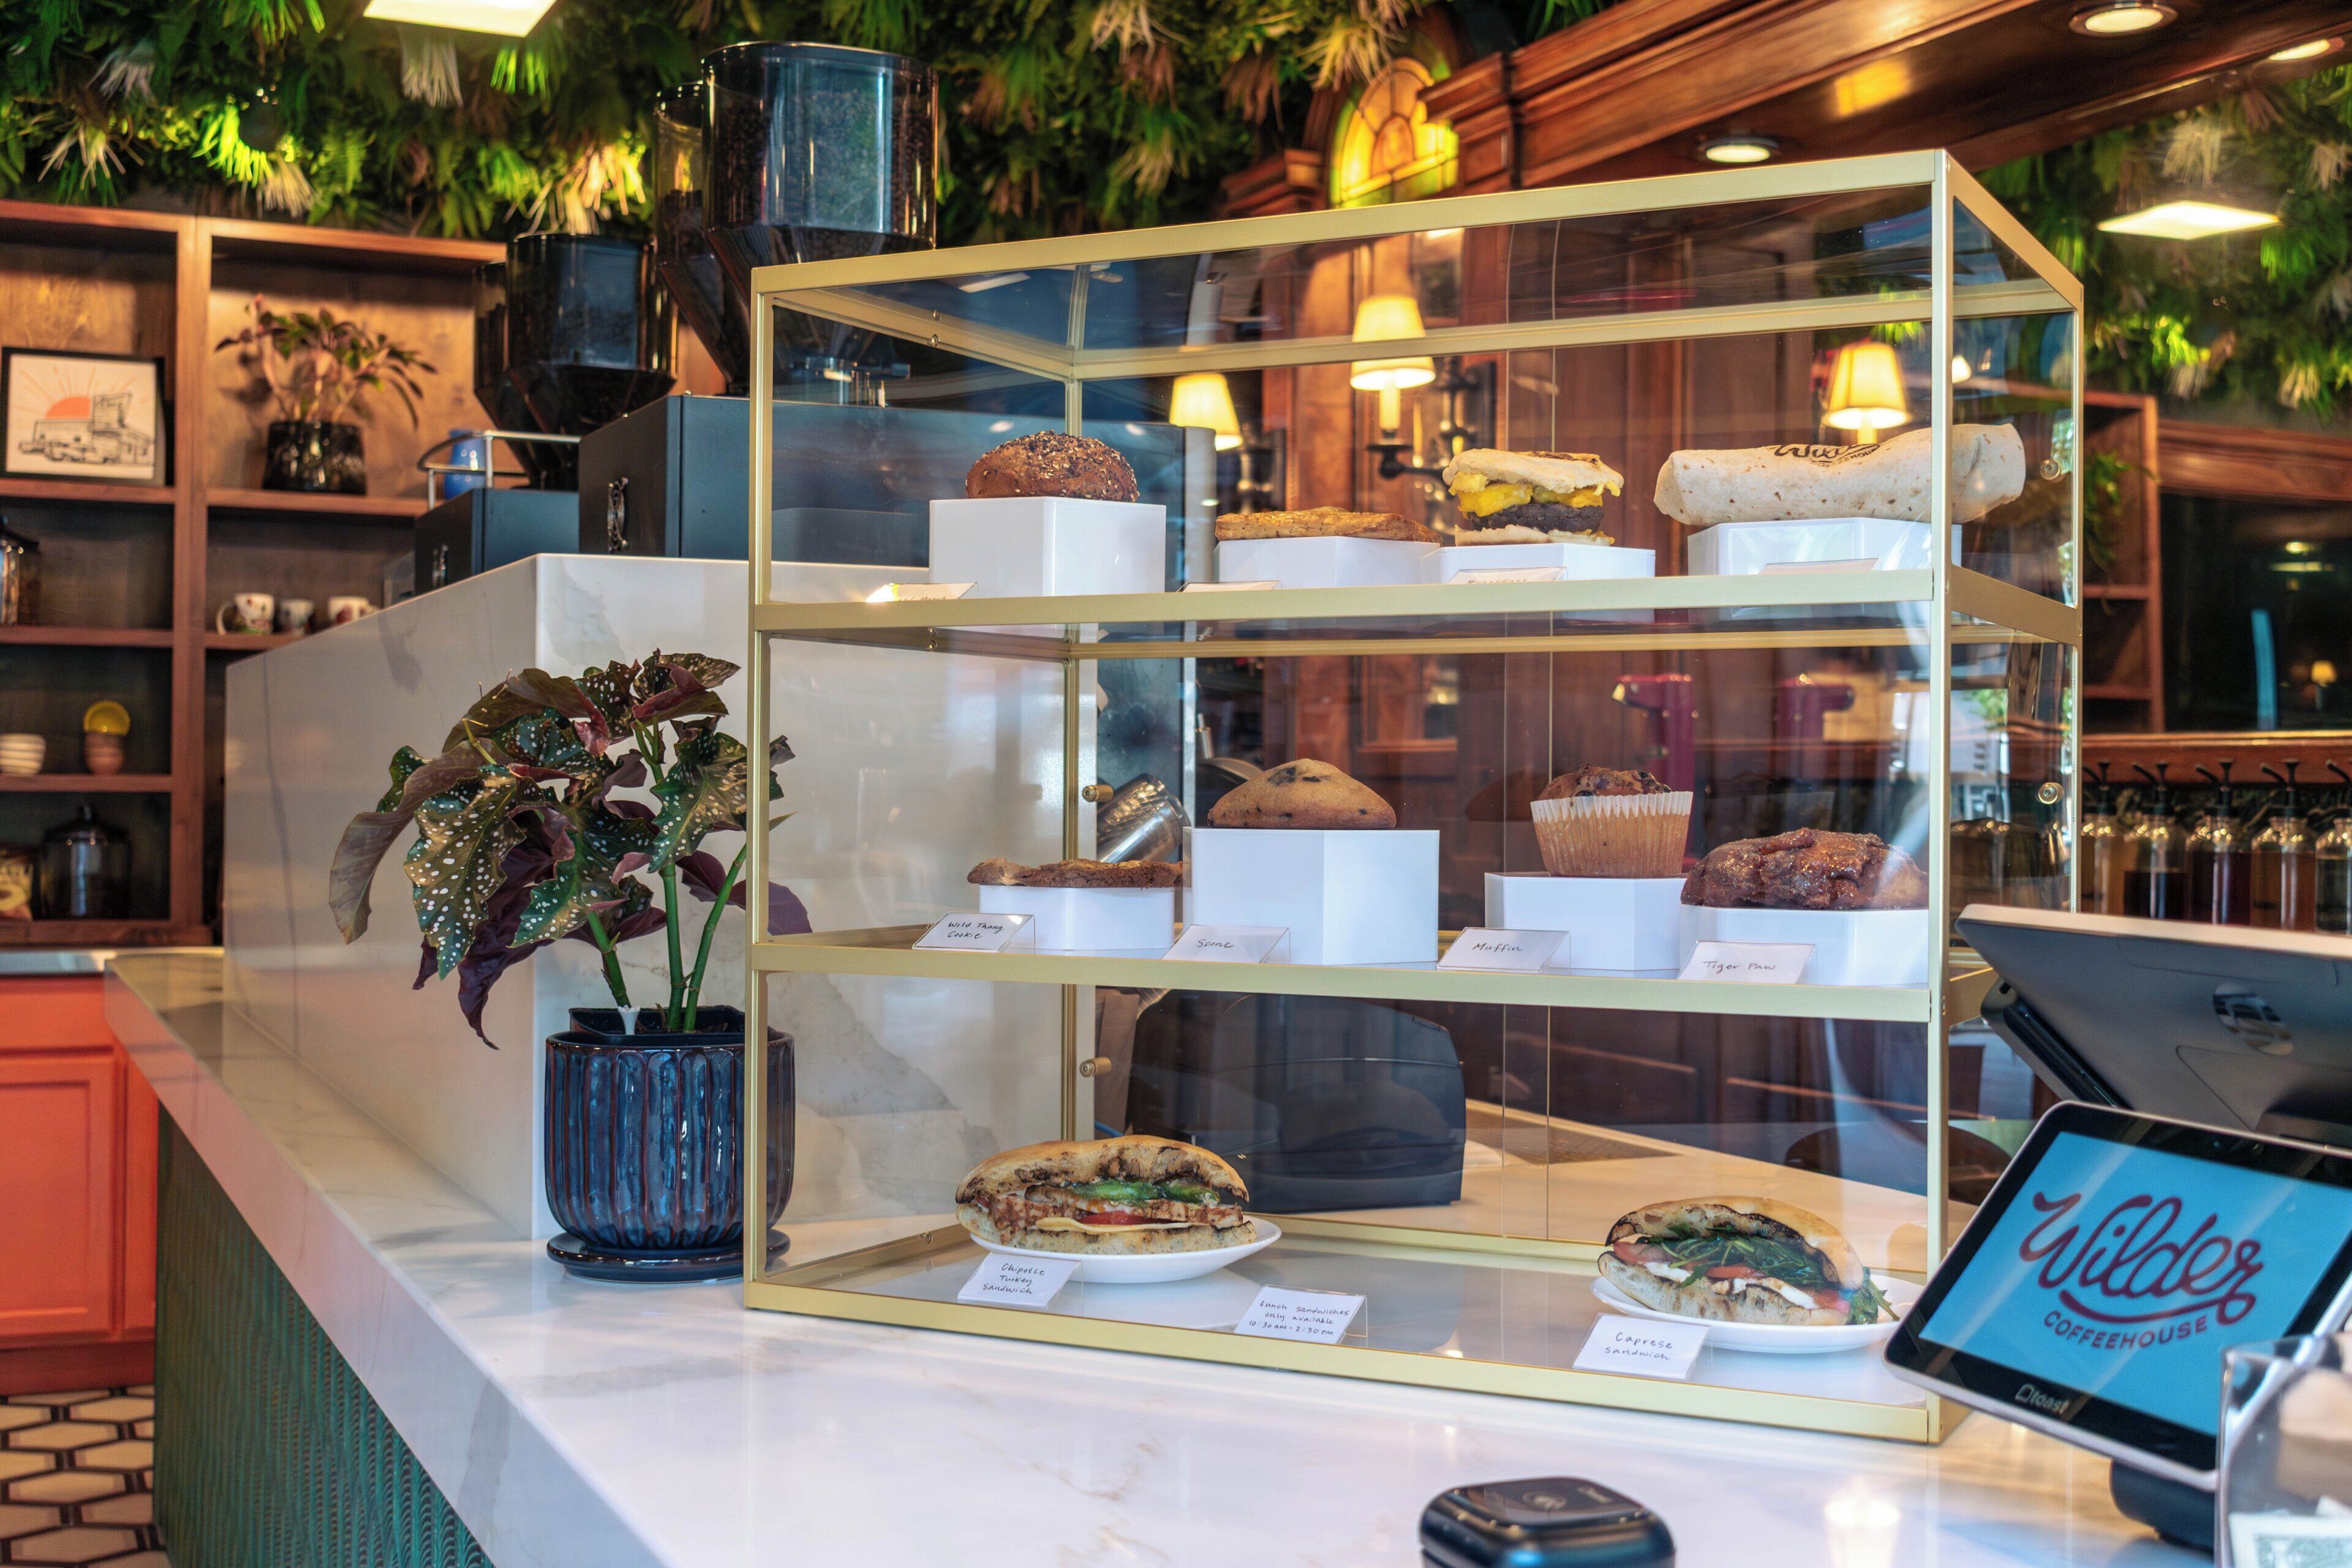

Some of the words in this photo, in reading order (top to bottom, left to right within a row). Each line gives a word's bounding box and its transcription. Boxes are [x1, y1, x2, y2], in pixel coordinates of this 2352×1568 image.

[977, 922, 1005, 934] Thang
[948, 930, 983, 939] Cookie
[1197, 938, 1235, 948] Scone
[1472, 942, 1523, 952] Muffin
[1703, 960, 1742, 974] Tiger
[2019, 1191, 2263, 1325] Wilder
[1001, 1263, 1046, 1275] Chipotle
[1000, 1275, 1033, 1287] Turkey
[1260, 1300, 1287, 1310] Lunch
[1265, 1313, 1285, 1321] only
[2043, 1311, 2208, 1349] COFFEEHOUSE
[1616, 1332, 1672, 1349] Caprese
